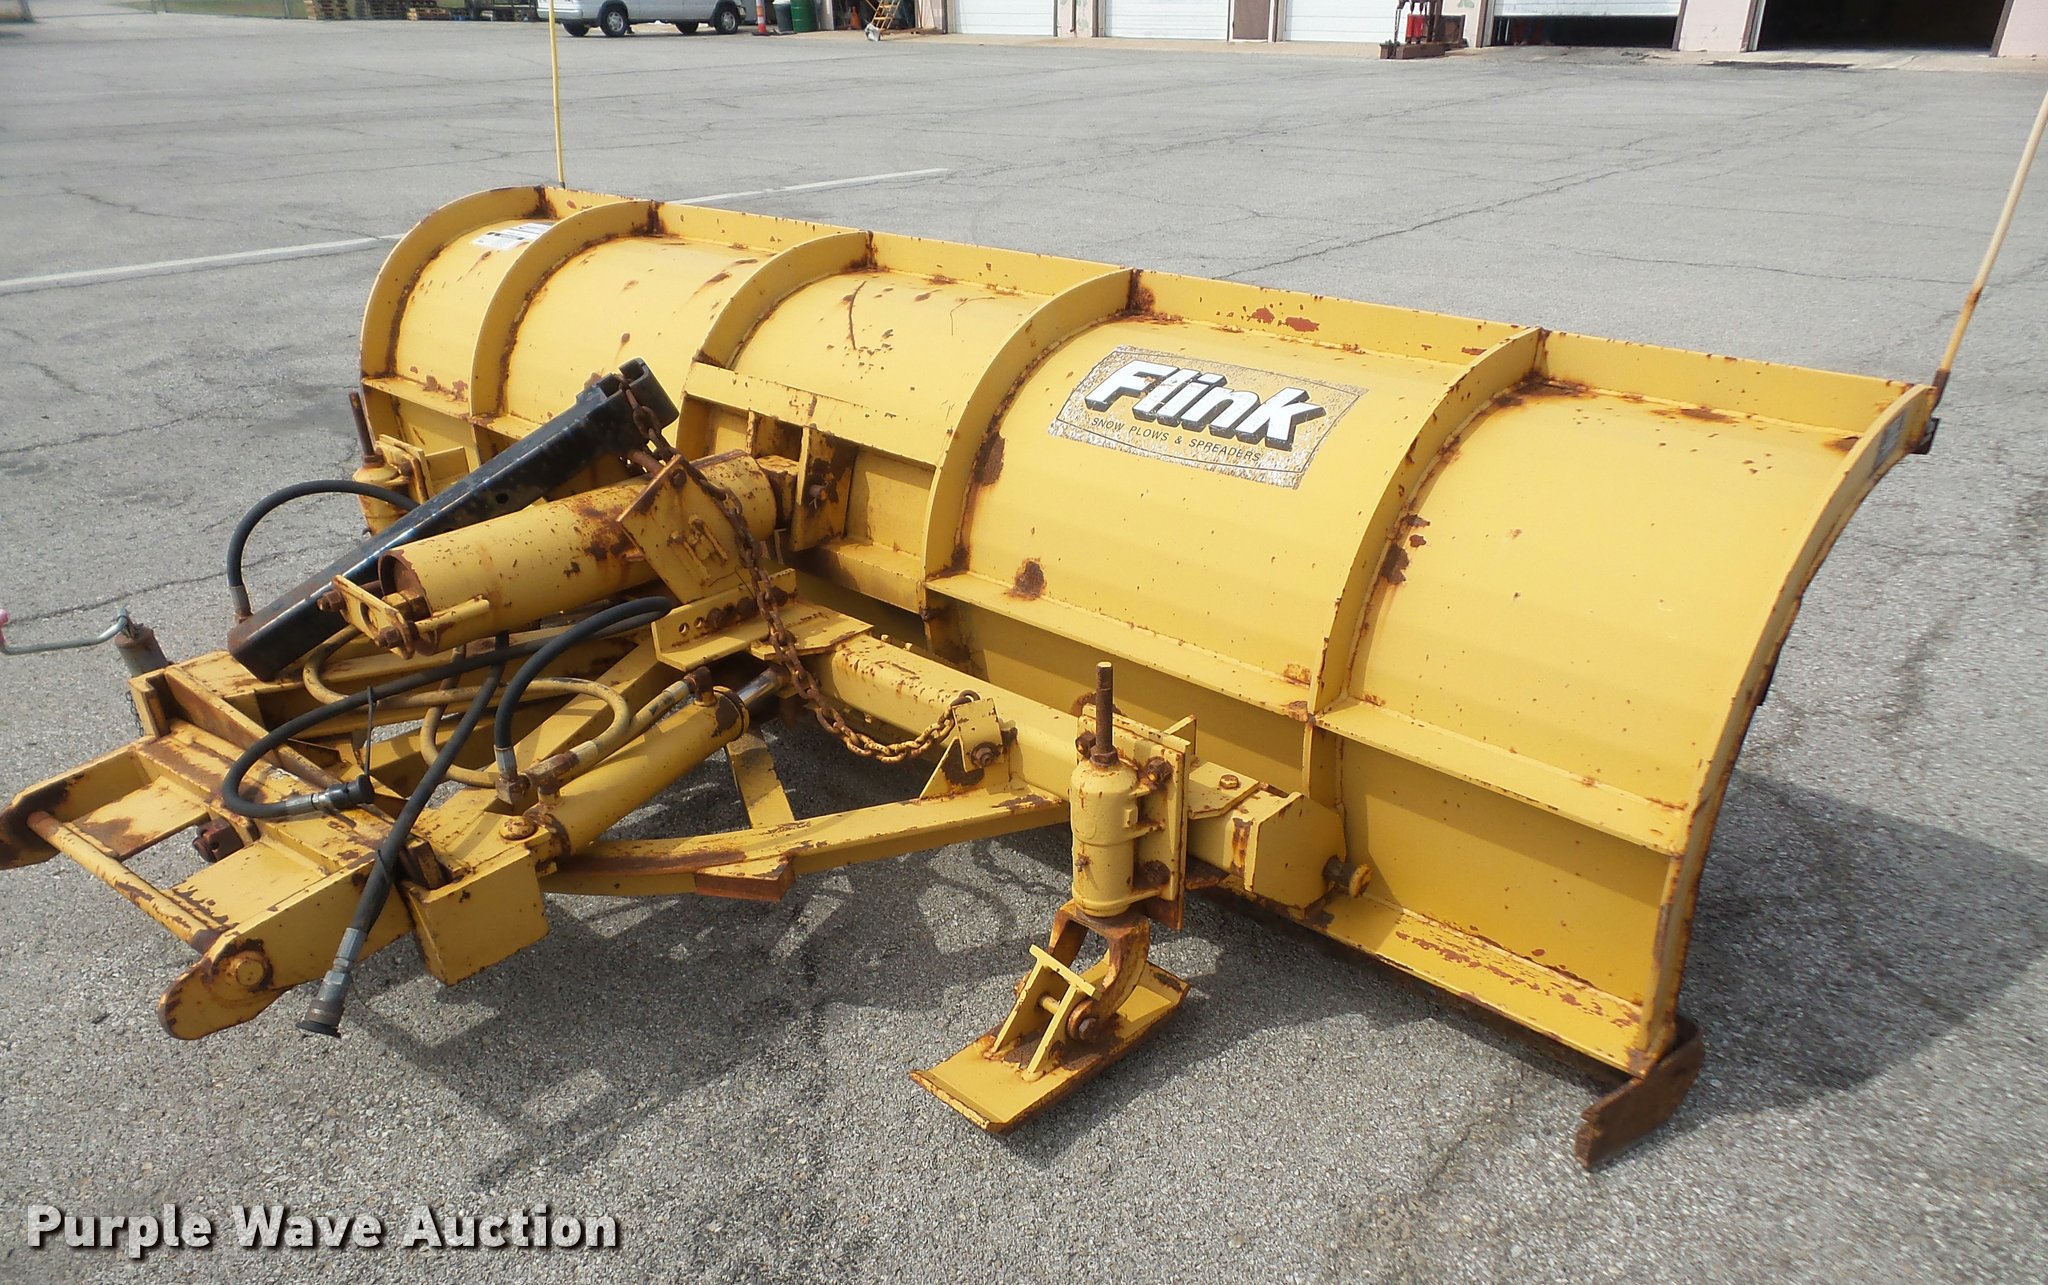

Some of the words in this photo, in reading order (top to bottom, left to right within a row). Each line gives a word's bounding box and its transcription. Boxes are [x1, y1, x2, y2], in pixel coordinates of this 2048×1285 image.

[1085, 359, 1327, 451] Flink
[1090, 417, 1124, 431] SNOW
[1129, 426, 1168, 442] PLOWS
[1174, 435, 1182, 445] &
[1188, 438, 1262, 462] SPREADERS
